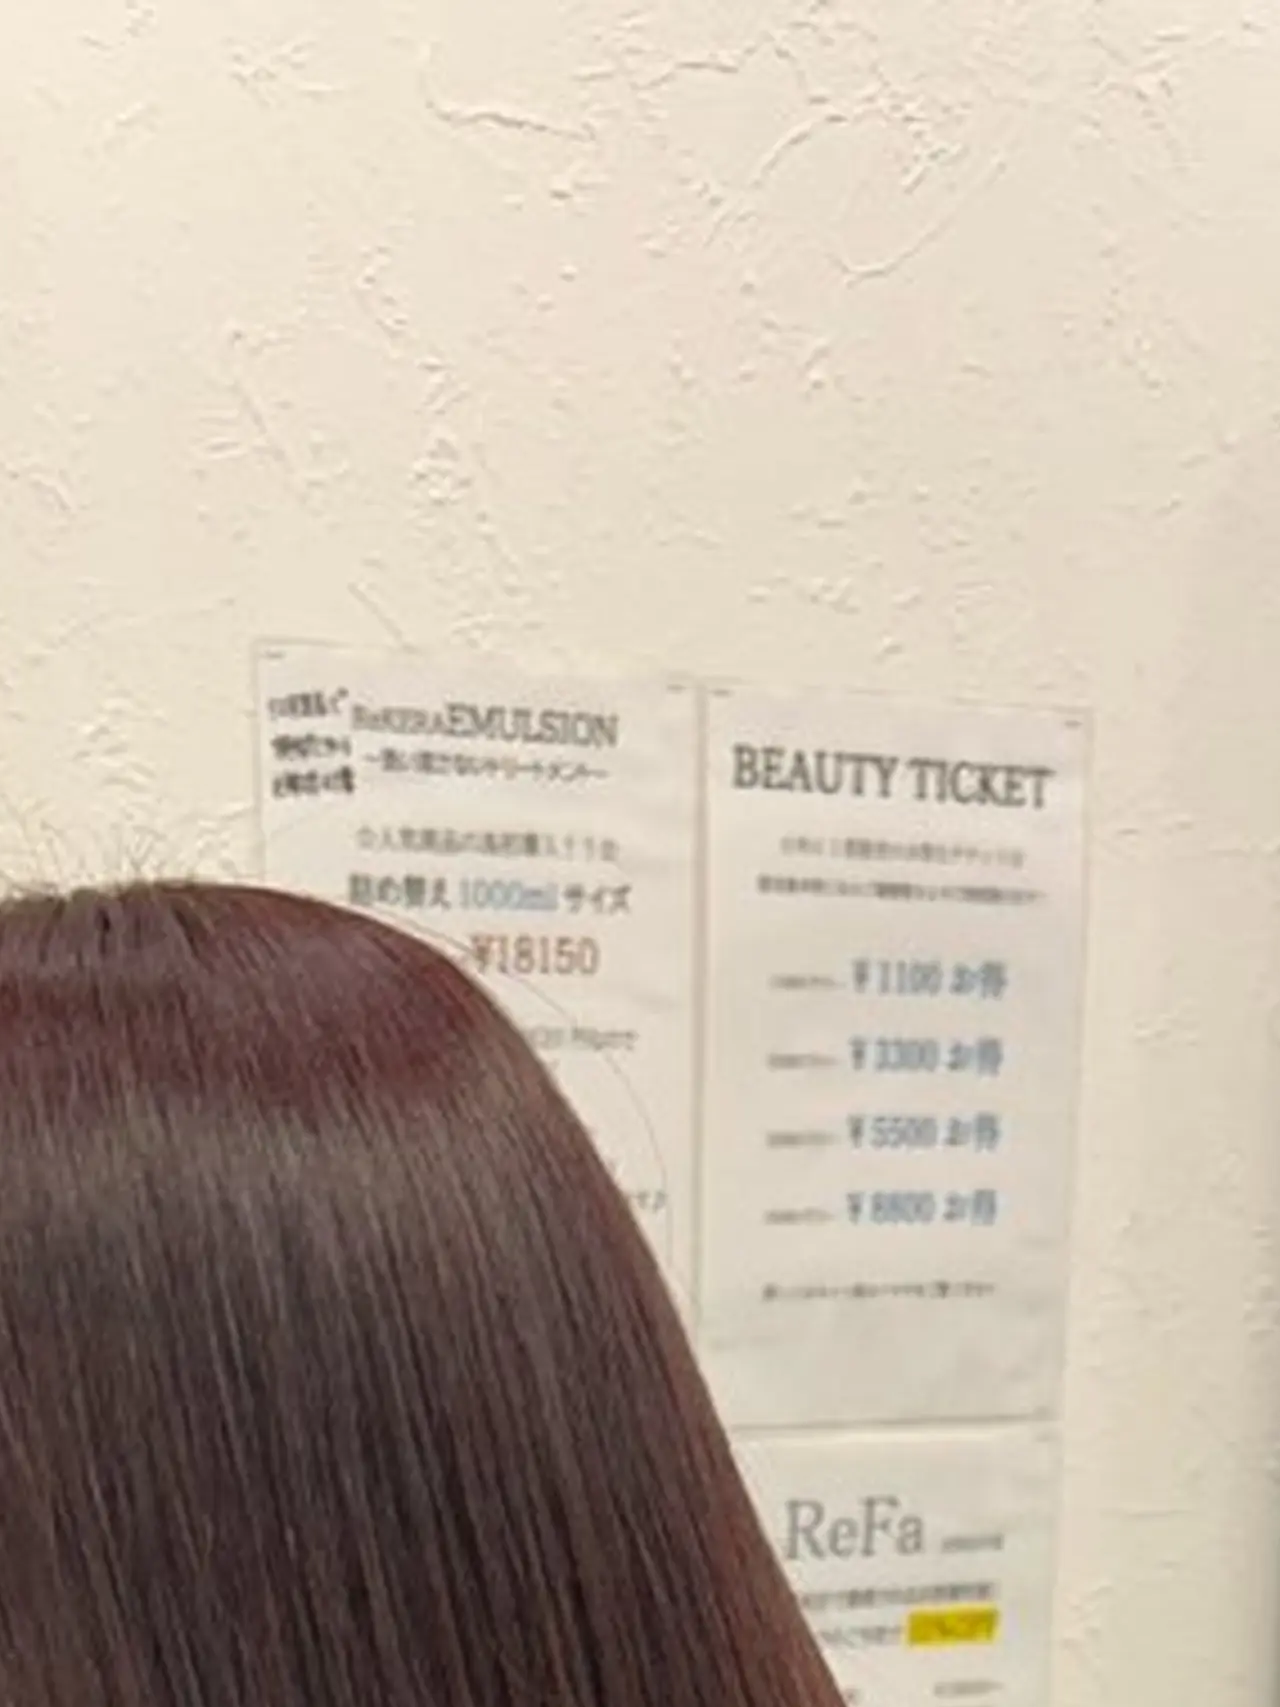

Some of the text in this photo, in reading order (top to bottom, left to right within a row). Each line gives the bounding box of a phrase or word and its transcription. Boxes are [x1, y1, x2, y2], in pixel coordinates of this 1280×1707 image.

[732, 743, 1055, 808] BEAUTY TICKET
[785, 1494, 926, 1560] ReFa
